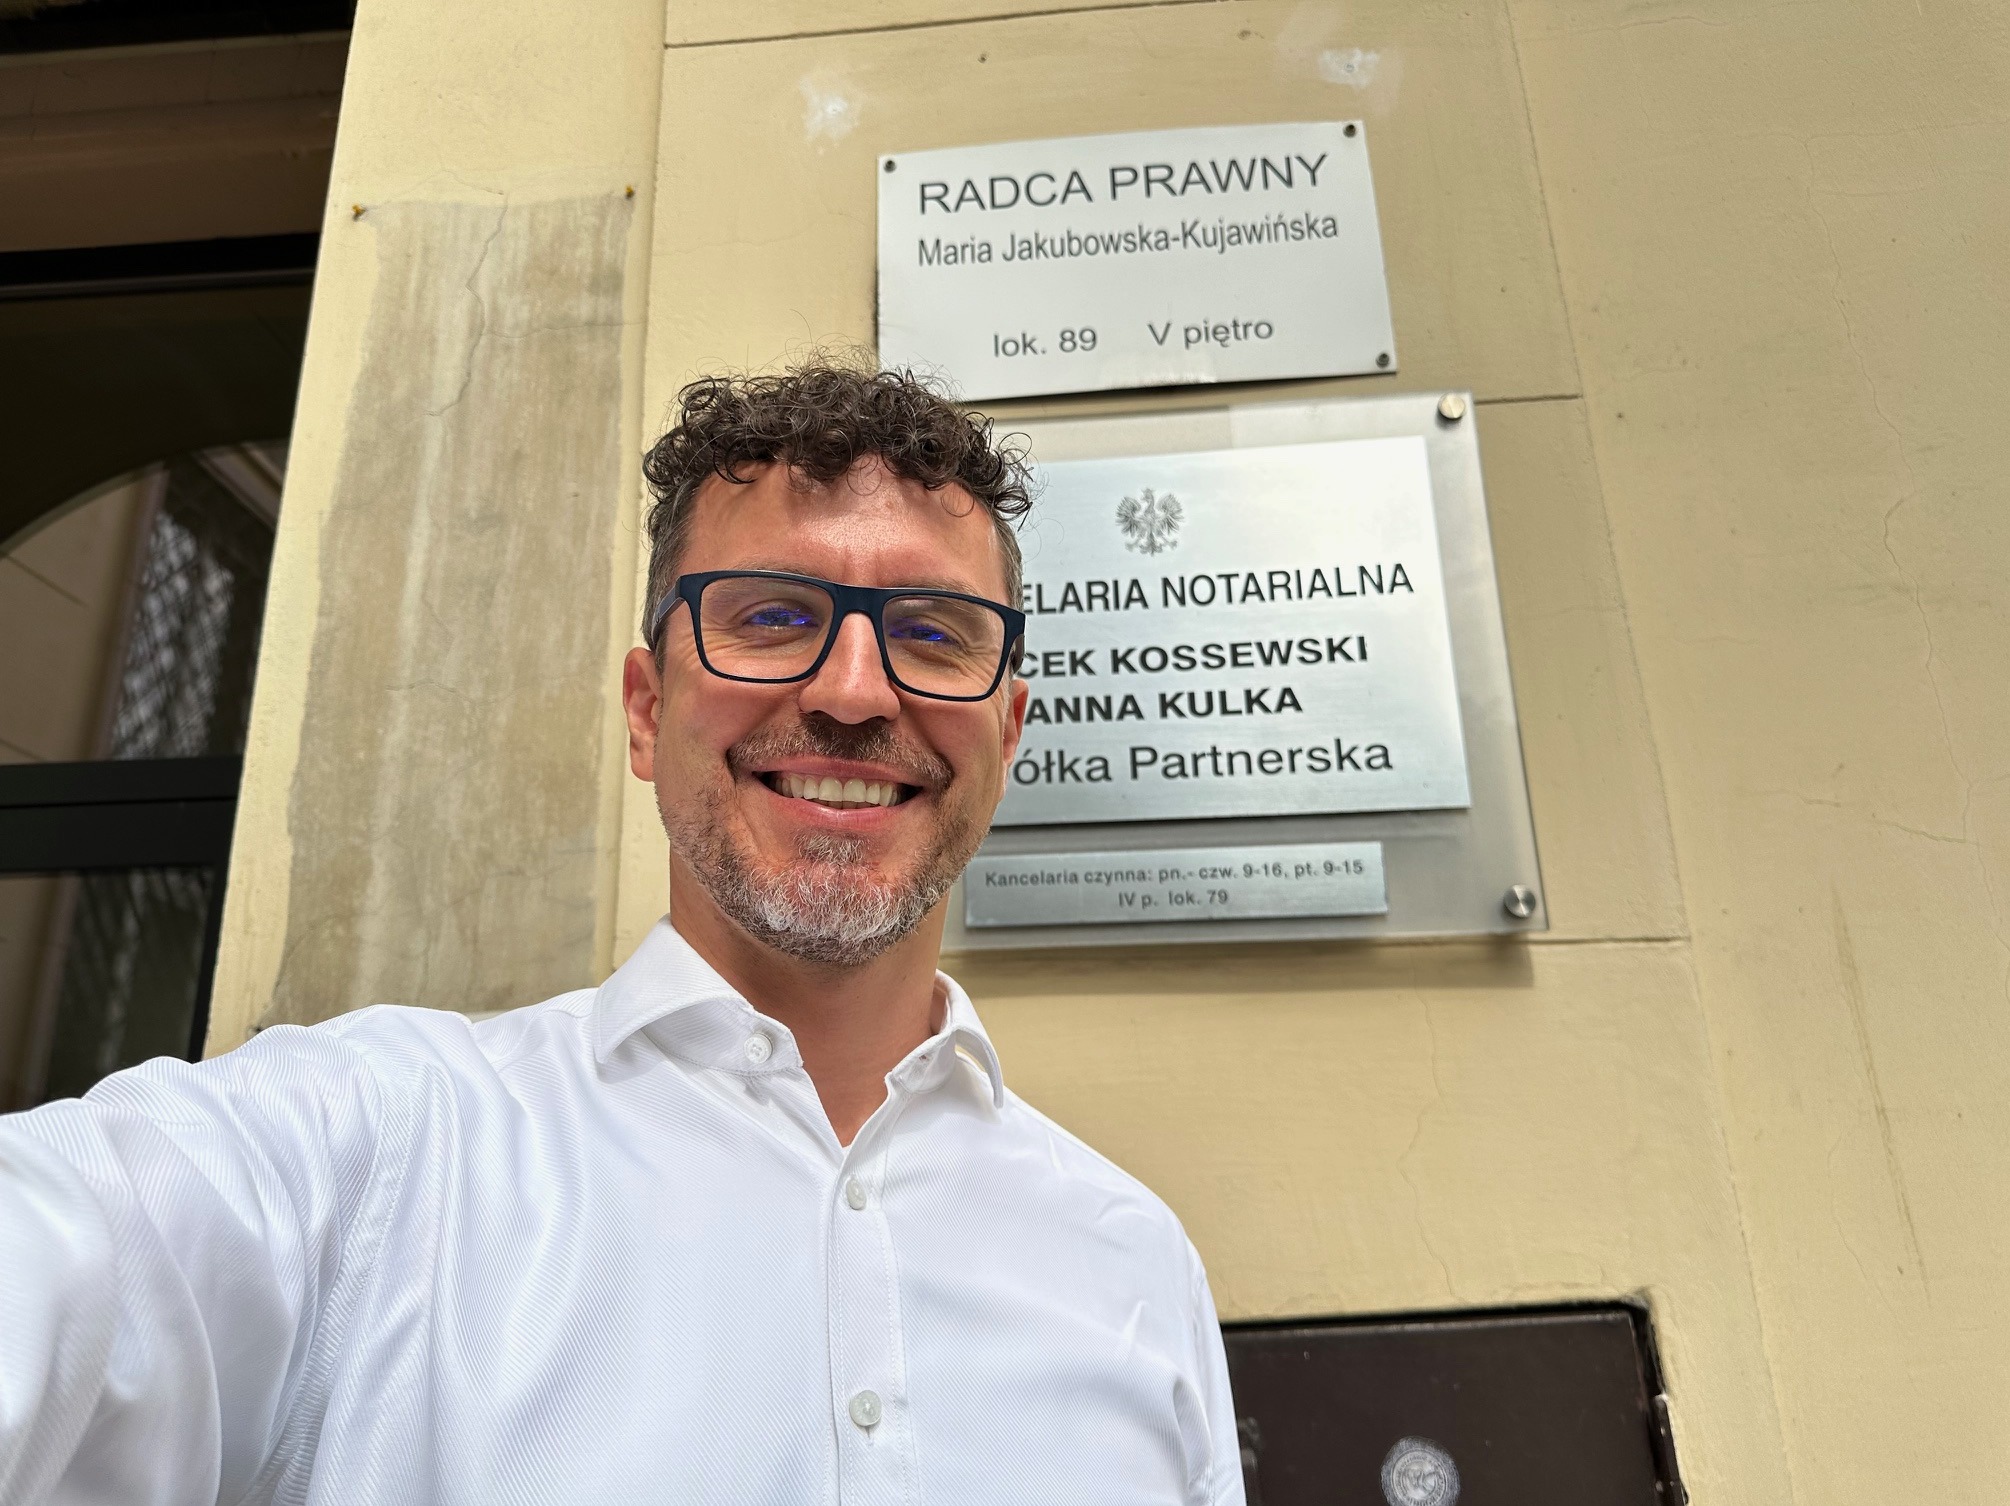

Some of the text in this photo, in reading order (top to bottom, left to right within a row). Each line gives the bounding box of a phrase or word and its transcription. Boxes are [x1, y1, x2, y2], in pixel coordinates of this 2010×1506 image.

[919, 152, 1328, 215] RADCA PRAWNY
[918, 212, 1338, 266] Maria Jakubowska-Kujawińska
[994, 318, 1273, 357] lok. 89 V piętro
[1161, 563, 1414, 608] NOTARIALNA
[1110, 635, 1368, 674] KOSSEWSKI
[1158, 687, 1303, 719] KULKA
[1129, 737, 1393, 780] Partnerska
[986, 870, 1079, 887] Kancelaria
[1084, 870, 1152, 886] czynna:
[1199, 867, 1238, 880] czw.
[1294, 861, 1319, 880] pt.
[1323, 859, 1365, 876] 9-15
[1119, 889, 1229, 910] IV p. lok. 79
